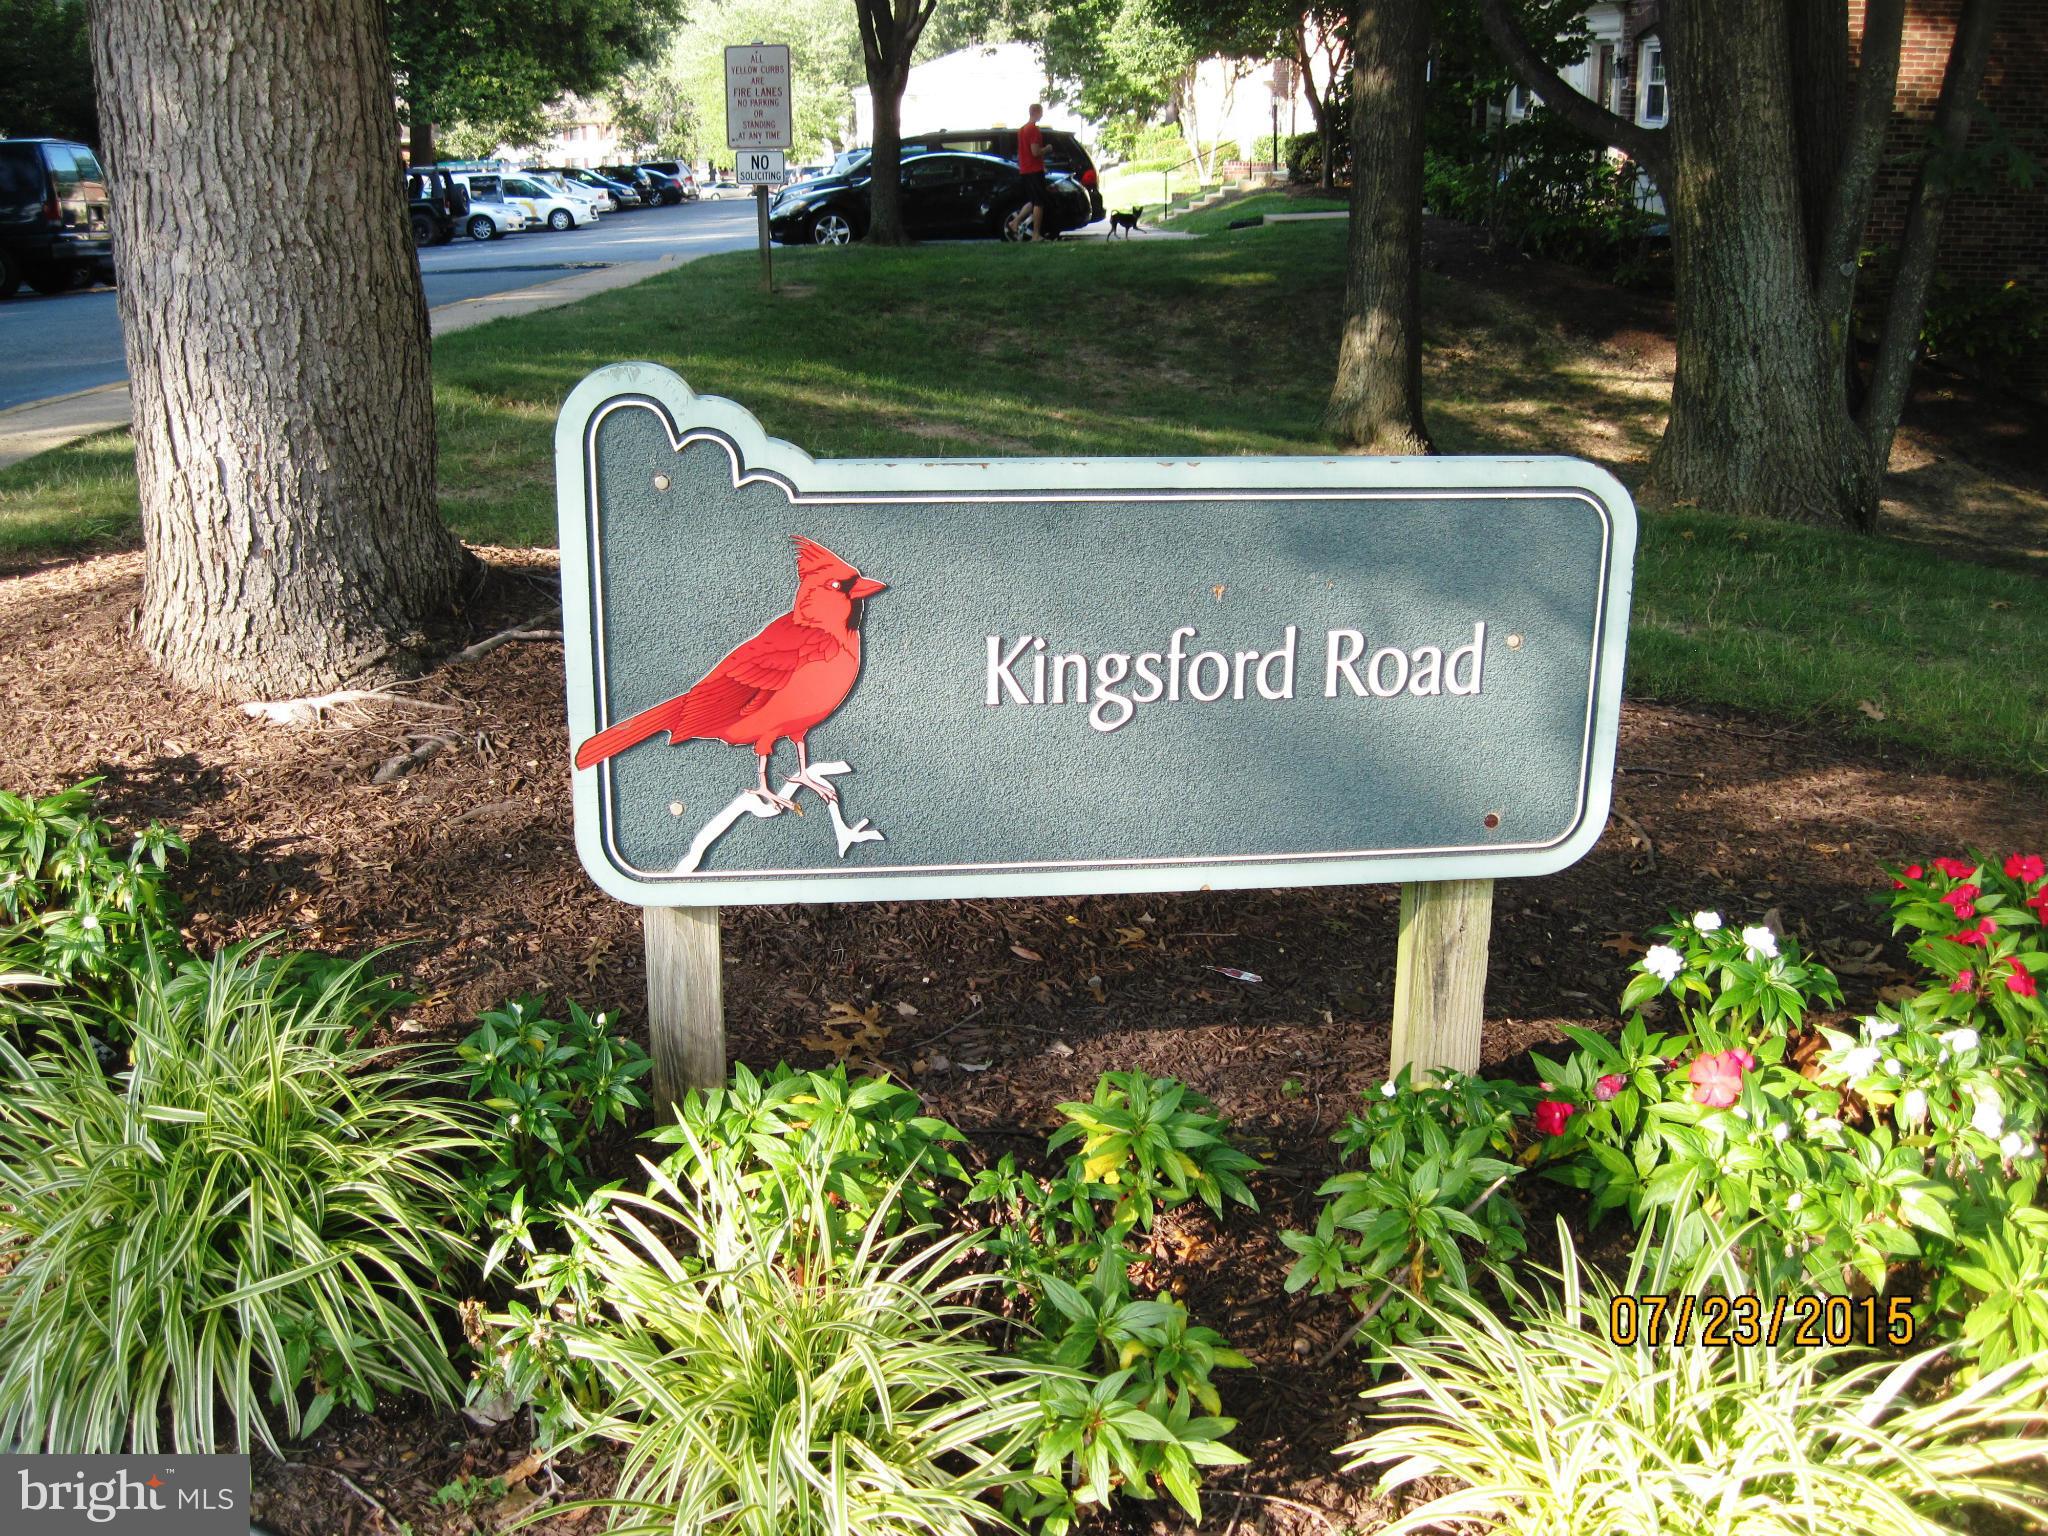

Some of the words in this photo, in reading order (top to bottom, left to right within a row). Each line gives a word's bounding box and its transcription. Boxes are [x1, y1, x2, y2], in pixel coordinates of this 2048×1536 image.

[751, 54, 763, 63] ALL
[732, 65, 758, 74] YELLOW
[761, 65, 784, 73] CURBS
[751, 77, 764, 85] ARE
[733, 87, 751, 97] FIRE
[755, 87, 783, 97] LANES
[737, 99, 747, 107] NO
[751, 98, 779, 107] PARKING
[753, 110, 763, 118] OR
[743, 120, 775, 129] STANDING
[739, 131, 745, 139] AT
[749, 131, 761, 139] ANY
[765, 130, 780, 139] TIME
[751, 154, 769, 170] NO
[740, 171, 781, 181] SOLICITING
[985, 625, 1297, 732] Kingsford
[1324, 622, 1486, 698] Road
